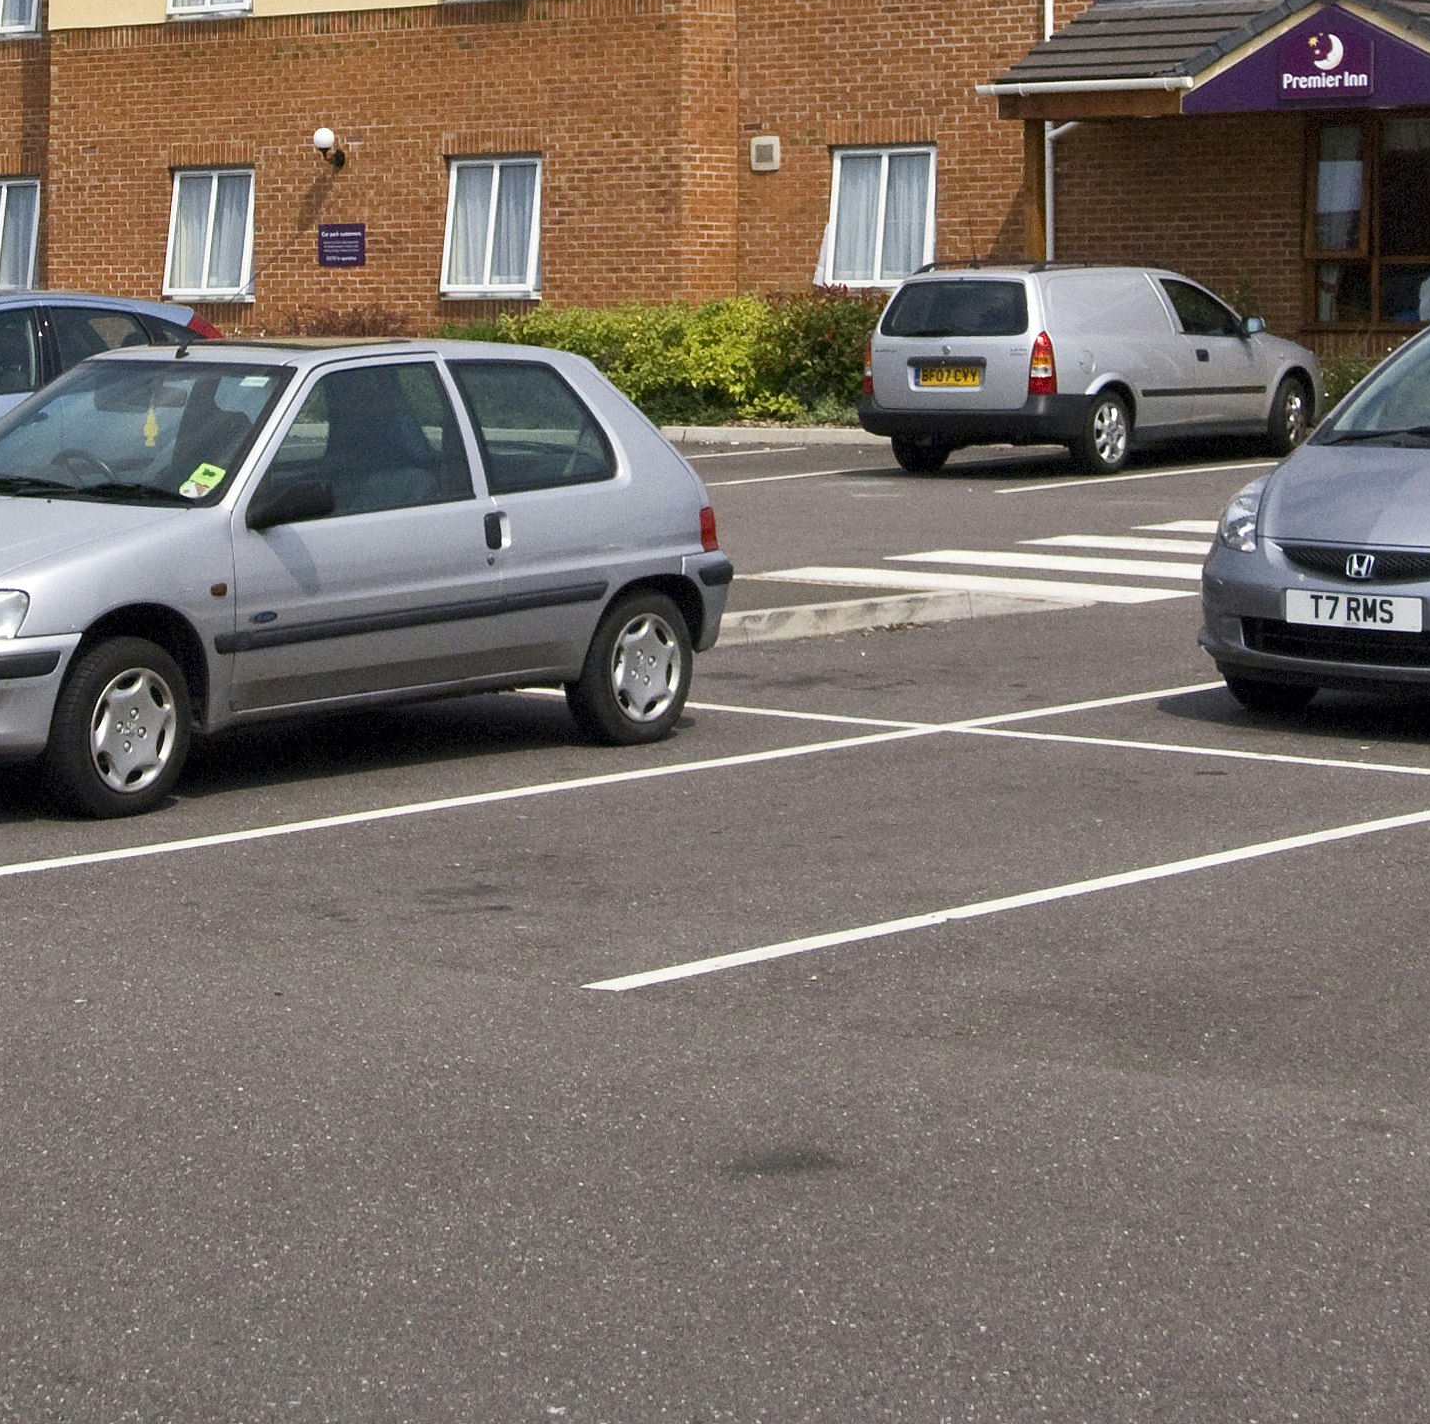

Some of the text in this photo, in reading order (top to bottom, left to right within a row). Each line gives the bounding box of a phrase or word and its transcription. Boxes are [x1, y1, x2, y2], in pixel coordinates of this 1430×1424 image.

[1282, 71, 1368, 89] Premier Inn
[1310, 594, 1394, 624] T7 RMS
